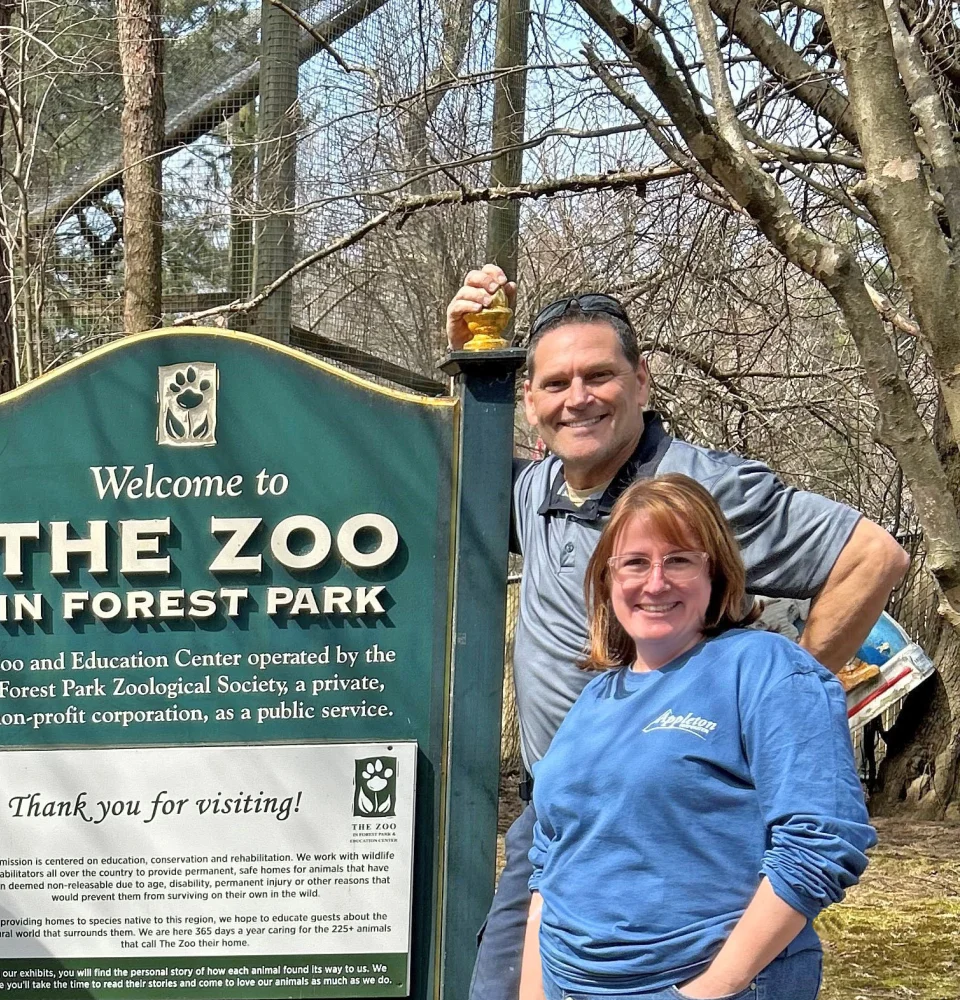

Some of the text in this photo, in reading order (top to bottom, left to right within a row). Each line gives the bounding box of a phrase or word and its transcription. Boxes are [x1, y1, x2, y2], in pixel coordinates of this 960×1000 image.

[89, 463, 288, 499] Welcome to
[208, 513, 398, 571] ZOO
[62, 587, 247, 618] FOREST
[266, 585, 385, 613] PARK
[30, 651, 65, 670] and
[70, 650, 169, 669] Education
[174, 648, 242, 667] Center
[247, 645, 329, 669] operated
[335, 644, 359, 667] by
[365, 643, 396, 663] the
[61, 677, 106, 697] Park
[112, 675, 211, 698] Zoological
[217, 675, 288, 696] Society,
[295, 680, 306, 692] a
[311, 673, 384, 695] private,
[91, 704, 208, 726] corporation,
[215, 708, 234, 720] as
[240, 707, 251, 719] a
[257, 700, 315, 723] public
[321, 699, 393, 718] service.
[644, 708, 717, 733] Appleton
[8, 790, 303, 825] Thank you for visiting!
[35, 857, 42, 865] is
[44, 856, 84, 865] centered
[100, 855, 147, 865] education,
[150, 855, 208, 864] conservation
[210, 854, 227, 862] and
[230, 853, 293, 862] rehabilitation.
[296, 852, 311, 861] We
[313, 852, 336, 861] work
[339, 851, 358, 860] with
[361, 850, 394, 860] wildlife
[46, 869, 57, 877] all
[81, 868, 96, 877] the
[98, 868, 133, 877] country
[135, 868, 145, 876] to
[147, 867, 182, 877] provide
[184, 866, 236, 876] permanent,
[239, 865, 258, 874] safe
[260, 865, 290, 874] homes
[293, 865, 306, 873] for
[308, 864, 343, 873] animals
[346, 863, 364, 872] that
[367, 863, 389, 872] have
[8, 881, 44, 890] deemed
[47, 880, 113, 889] non-releasable
[115, 880, 133, 888] due
[135, 880, 145, 888] to
[147, 881, 166, 889] age,
[169, 879, 212, 888] disability,
[214, 878, 263, 888] permanent
[266, 877, 292, 887] injury
[307, 876, 331, 885] other
[371, 875, 390, 884] that
[51, 892, 78, 901] would
[81, 892, 115, 902] prevent
[117, 892, 141, 900] them
[143, 891, 164, 900] from
[167, 891, 208, 900] surviving
[225, 890, 246, 899] their
[281, 889, 296, 898] the
[298, 888, 320, 897] wild.
[0, 917, 42, 927] providing
[45, 917, 74, 925] homes
[77, 917, 86, 925] to
[88, 916, 121, 926] species
[124, 916, 151, 924] native
[153, 916, 163, 924] to
[165, 915, 182, 923] this
[184, 915, 216, 924] region,
[234, 914, 257, 923] hope
[260, 914, 269, 922] to
[271, 913, 308, 922] educate
[310, 913, 340, 922] guests
[343, 912, 369, 921] about
[372, 912, 387, 920] the
[15, 928, 40, 938] world
[43, 929, 60, 937] that
[63, 928, 107, 937] surrounds
[110, 928, 135, 936] them.
[138, 927, 153, 936] We
[172, 927, 192, 935] here
[195, 926, 212, 935] 365
[214, 926, 235, 936] days
[246, 927, 265, 936] year
[267, 925, 296, 935] caring
[298, 924, 311, 933] for
[314, 924, 329, 933] the
[331, 924, 354, 933] 225+
[356, 923, 391, 932] animals
[19, 968, 56, 978] exhibits,
[58, 969, 74, 978] you
[76, 968, 91, 977] will
[93, 967, 111, 976] find
[113, 967, 128, 976] the
[130, 967, 168, 977] personal
[170, 967, 193, 977] story
[195, 966, 205, 975] of
[206, 966, 226, 975] how
[227, 965, 249, 975] each
[251, 965, 280, 974] animal
[282, 964, 309, 974] found
[311, 964, 322, 973] its
[324, 966, 342, 974] way
[344, 964, 354, 973] to
[356, 965, 369, 973] us.
[371, 963, 387, 972] We
